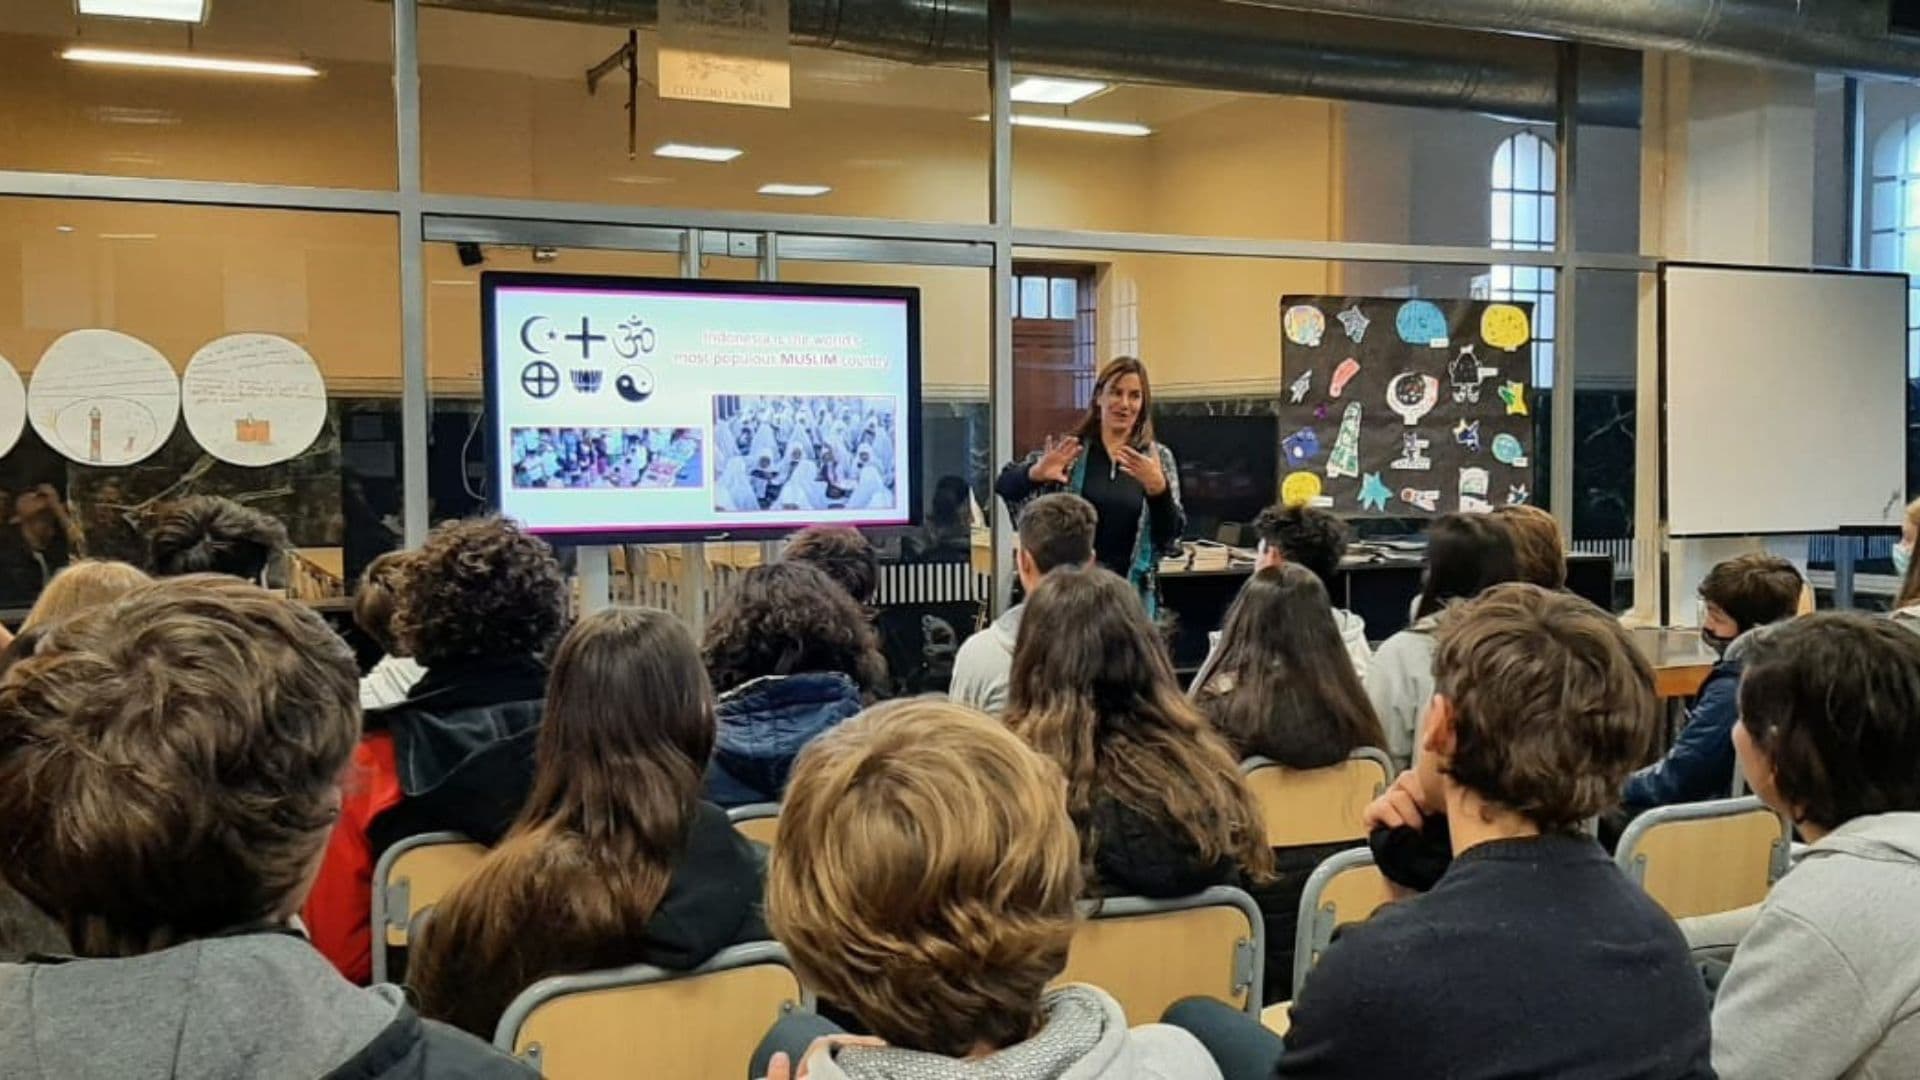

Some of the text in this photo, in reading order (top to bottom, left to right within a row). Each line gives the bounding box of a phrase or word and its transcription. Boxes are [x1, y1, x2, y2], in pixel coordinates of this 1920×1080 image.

[703, 331, 770, 346] Indonesia
[674, 352, 709, 364] most
[780, 351, 838, 366] MUSLIM
[842, 354, 889, 370] country
